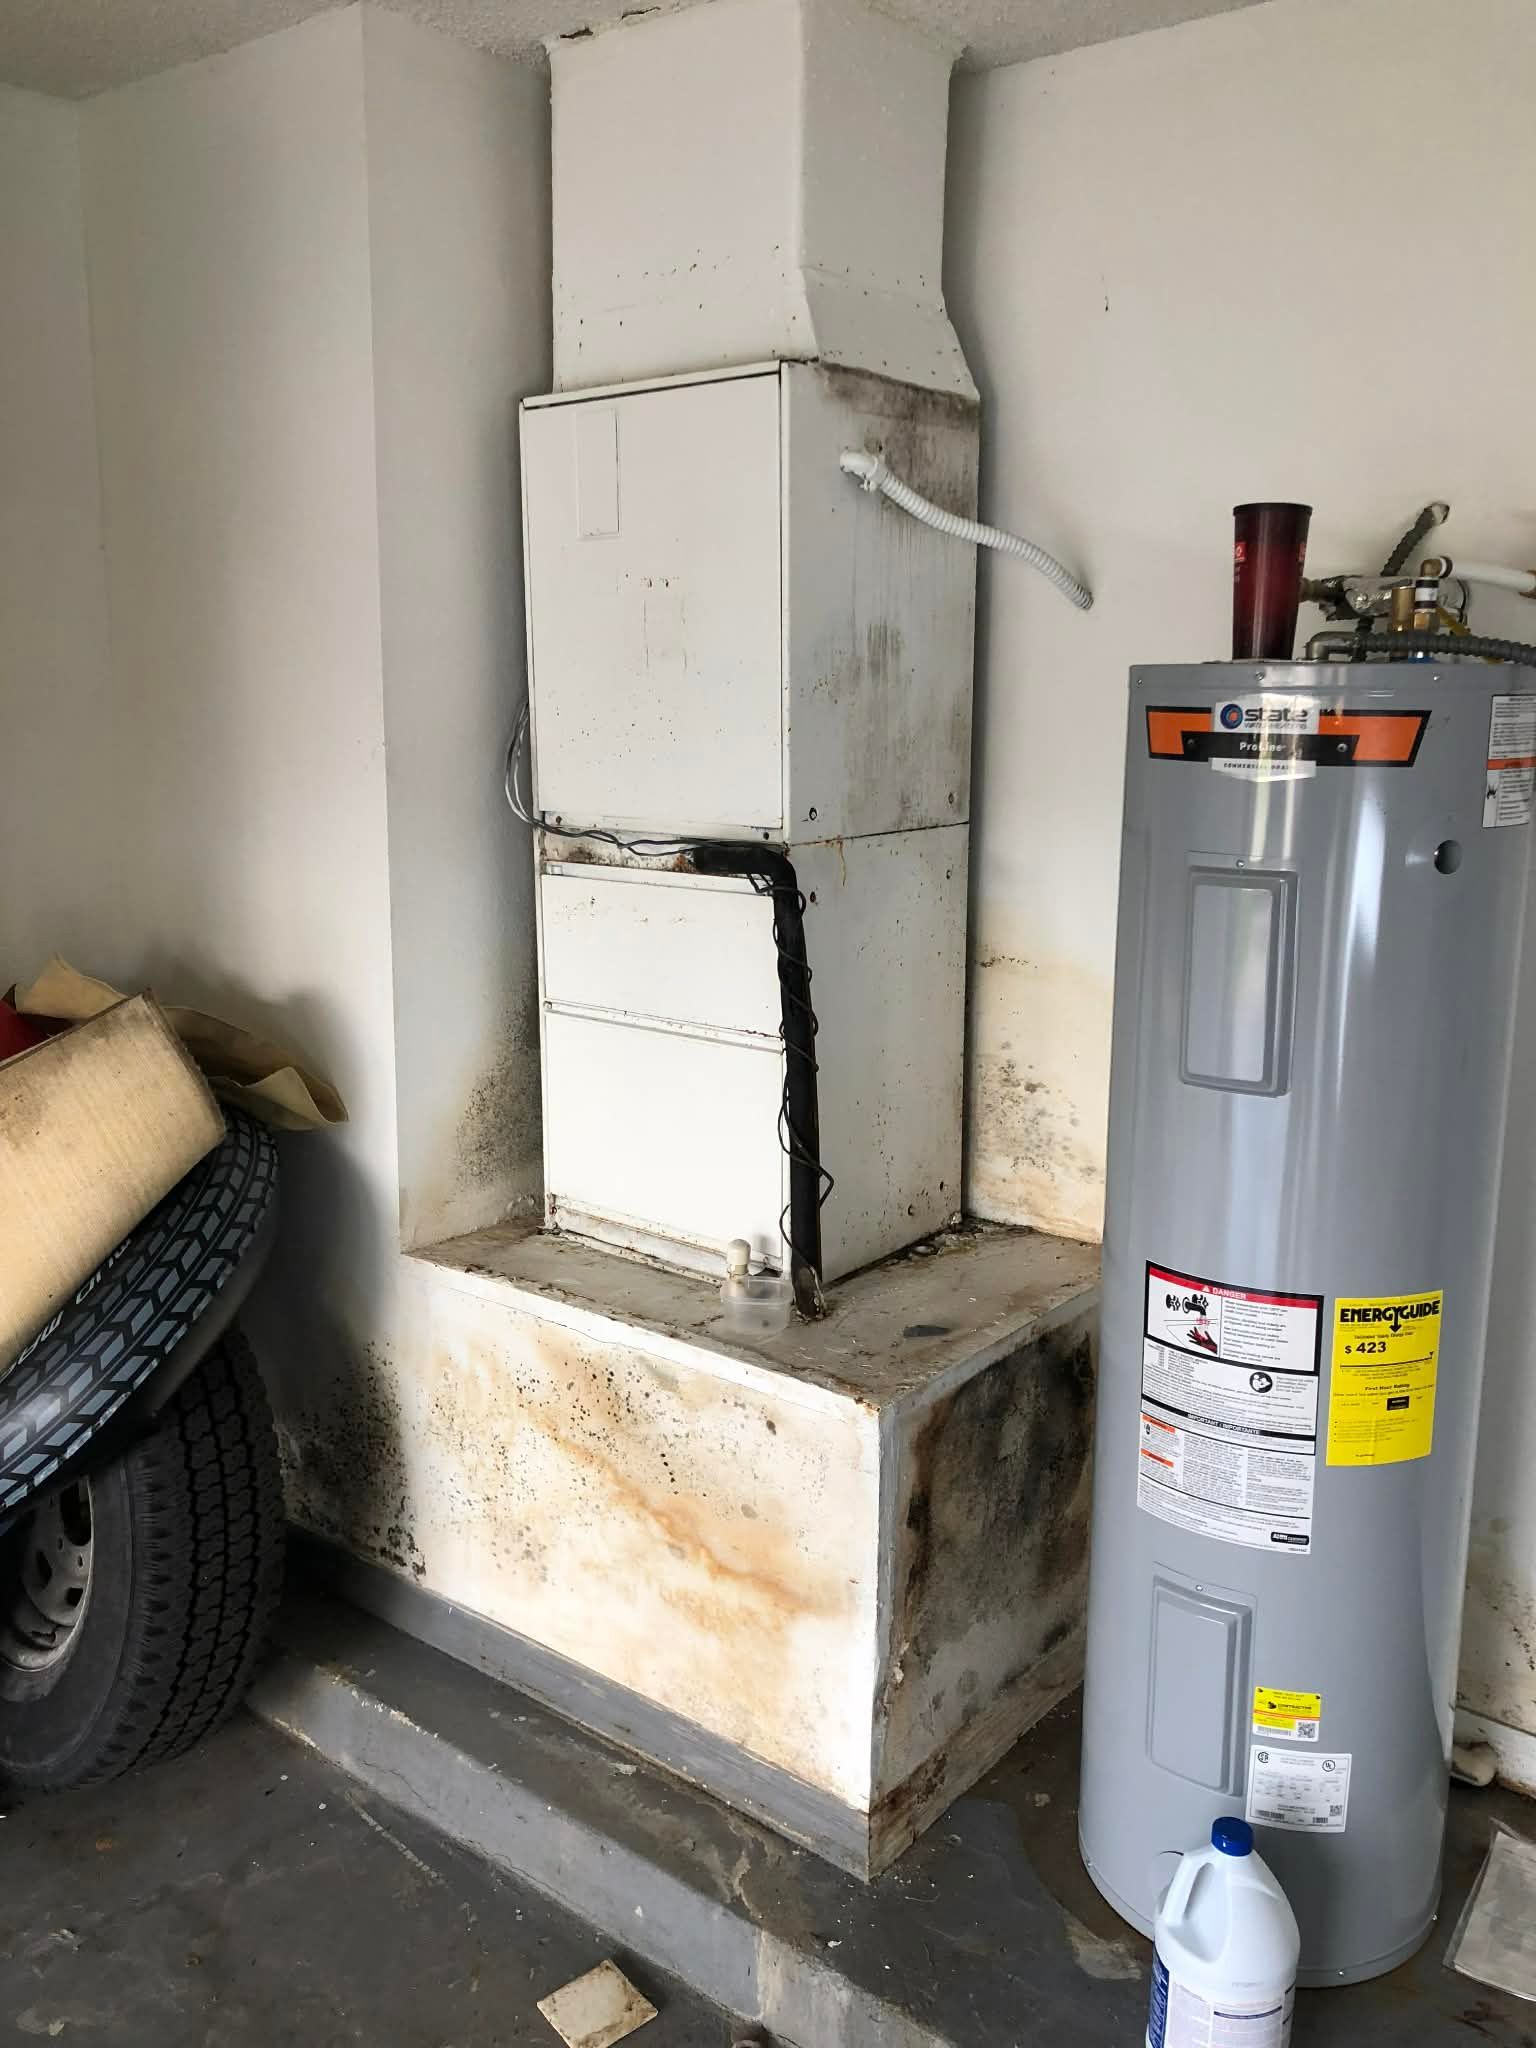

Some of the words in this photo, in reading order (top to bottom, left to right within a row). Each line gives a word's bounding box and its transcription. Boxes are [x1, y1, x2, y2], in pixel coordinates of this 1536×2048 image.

[1244, 707, 1308, 722] state
[1212, 1287, 1247, 1300] DANGER
[1340, 1300, 1440, 1323] ENERGYGUIDE
[1344, 1345, 1352, 1355] $
[1356, 1341, 1387, 1354] 423
